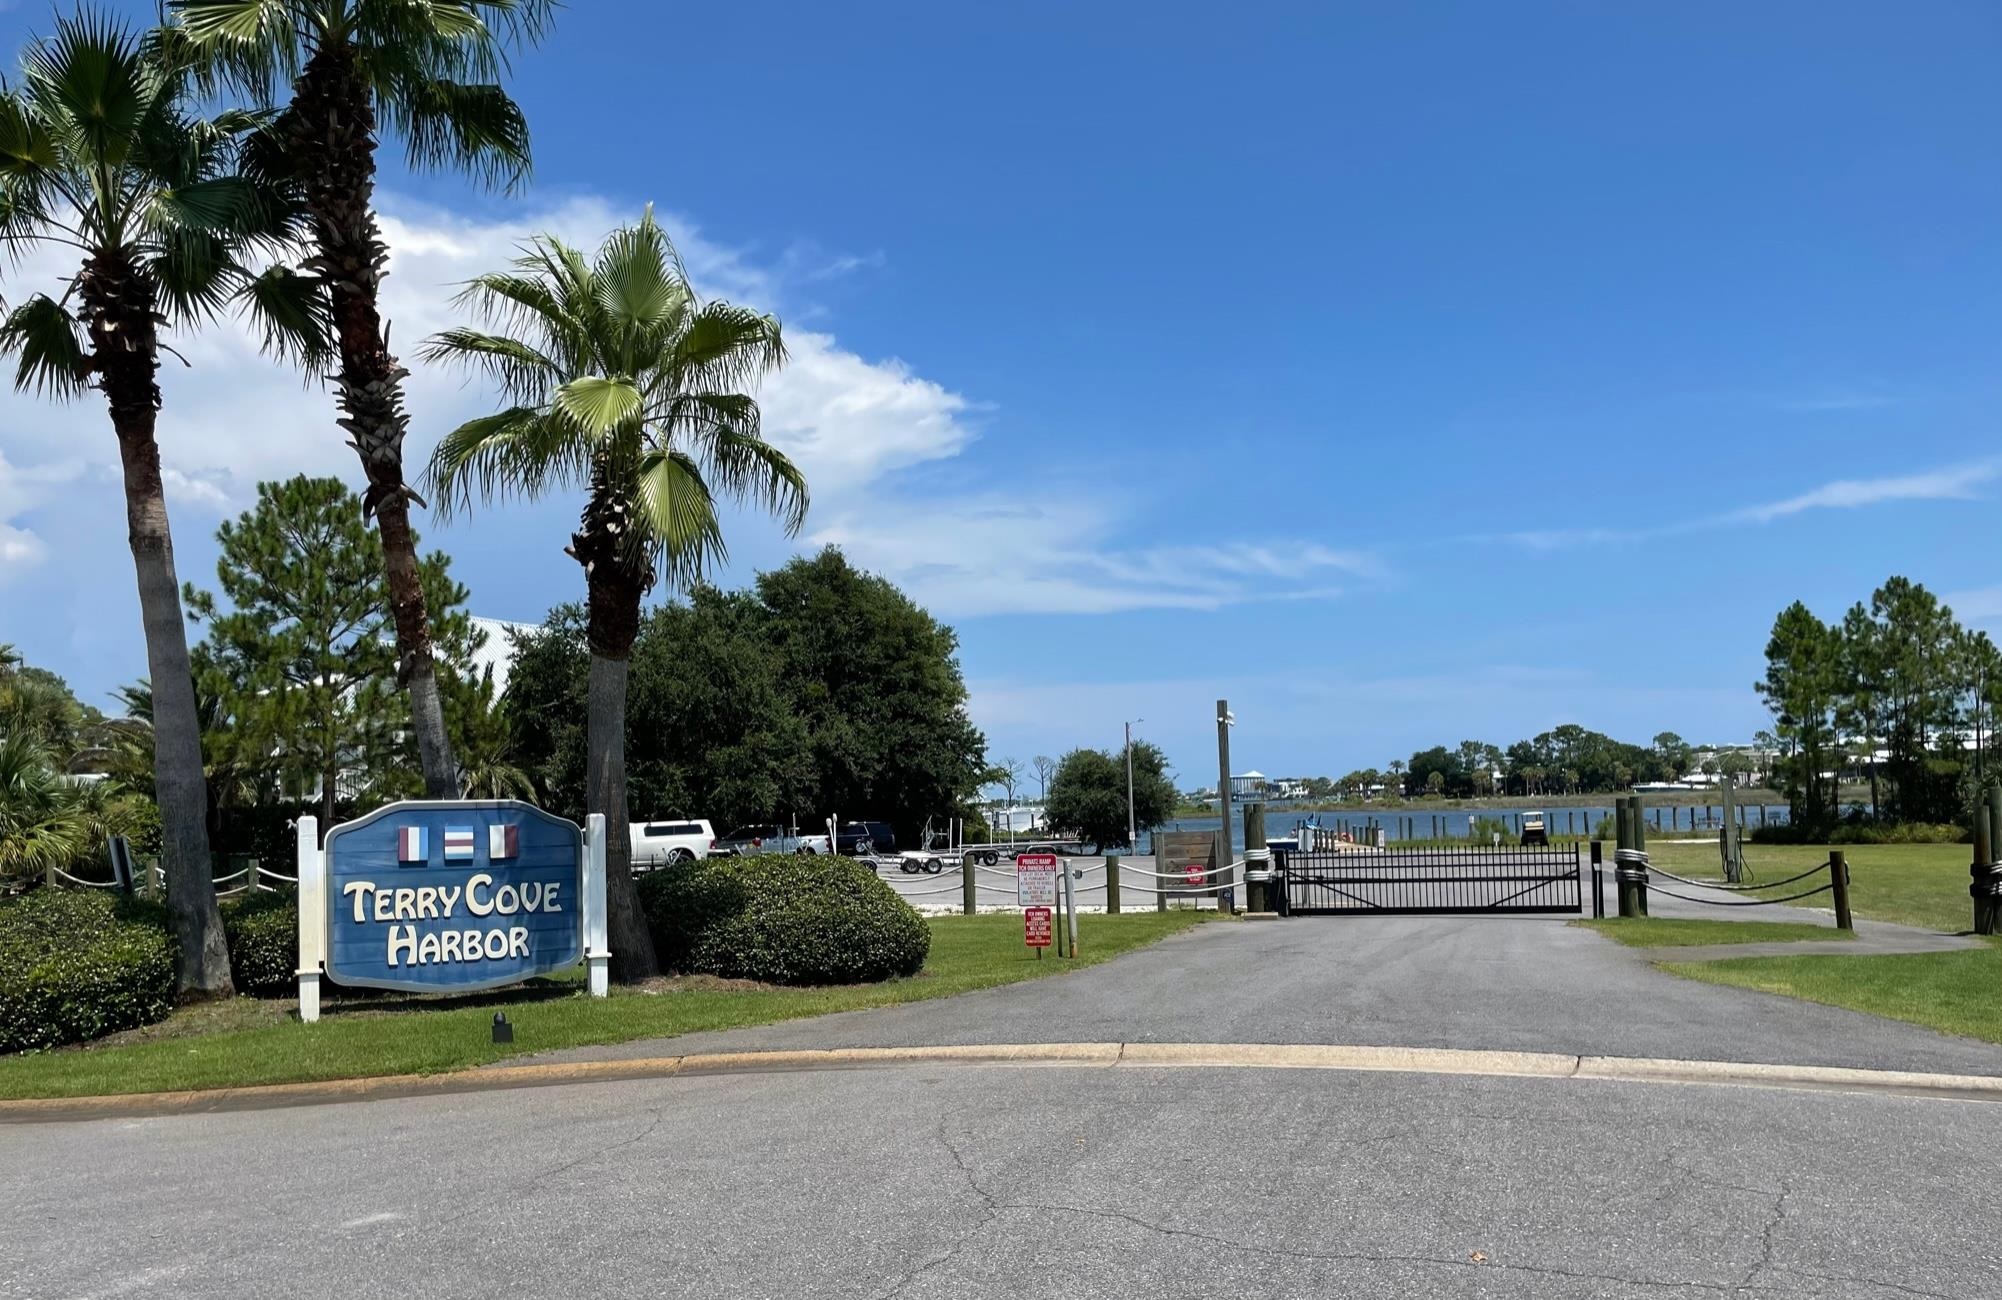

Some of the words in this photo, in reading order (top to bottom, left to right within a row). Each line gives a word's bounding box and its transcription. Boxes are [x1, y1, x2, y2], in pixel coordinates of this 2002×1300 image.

[343, 881, 461, 922] TERRY
[465, 874, 562, 916] COVE
[388, 925, 529, 966] HARBOR
